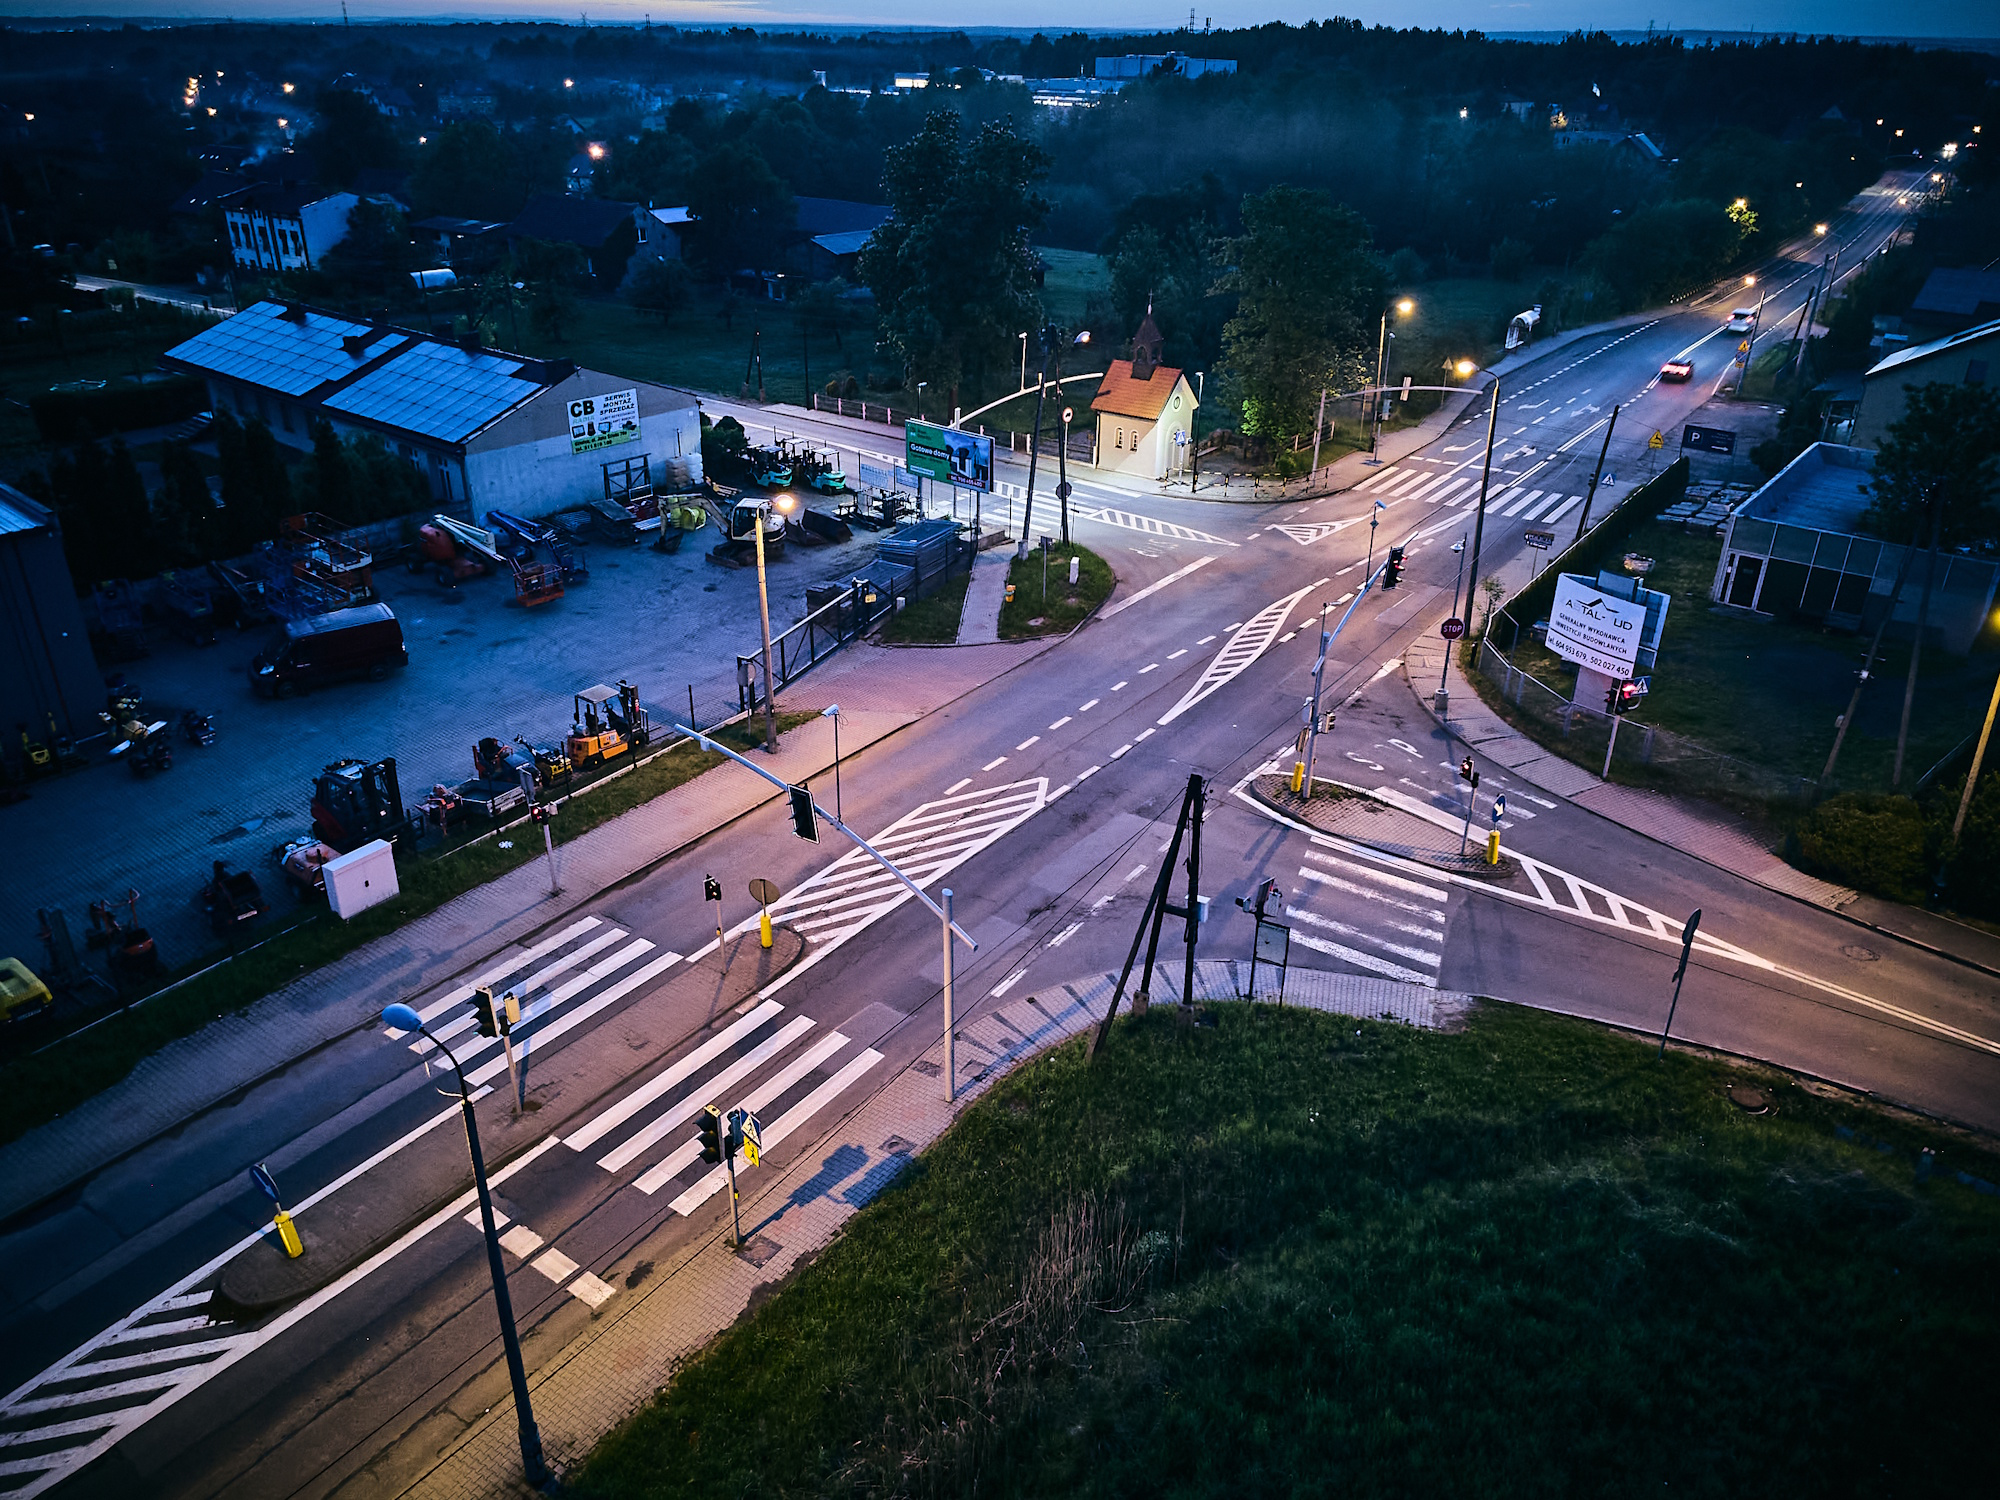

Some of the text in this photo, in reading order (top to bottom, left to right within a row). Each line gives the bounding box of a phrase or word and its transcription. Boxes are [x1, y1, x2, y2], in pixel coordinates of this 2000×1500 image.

[603, 398, 631, 408] MONTAŻ
[605, 392, 631, 401] SERWIS
[570, 400, 595, 417] CB
[600, 403, 635, 415] SPRZEDAŻ
[1691, 432, 1701, 442] P
[910, 443, 933, 455] Gotowe
[933, 449, 950, 460] domy
[1443, 625, 1463, 633] STOP
[1559, 612, 1625, 644] GENERALNY WYKONAWCA
[1555, 620, 1627, 655] INWESTYCJI BUDOWLANYCH
[1555, 640, 1565, 650] 604
[1565, 645, 1575, 655] 953
[1590, 656, 1602, 667] 502
[1602, 660, 1615, 671] 027
[1616, 666, 1630, 676] 450
